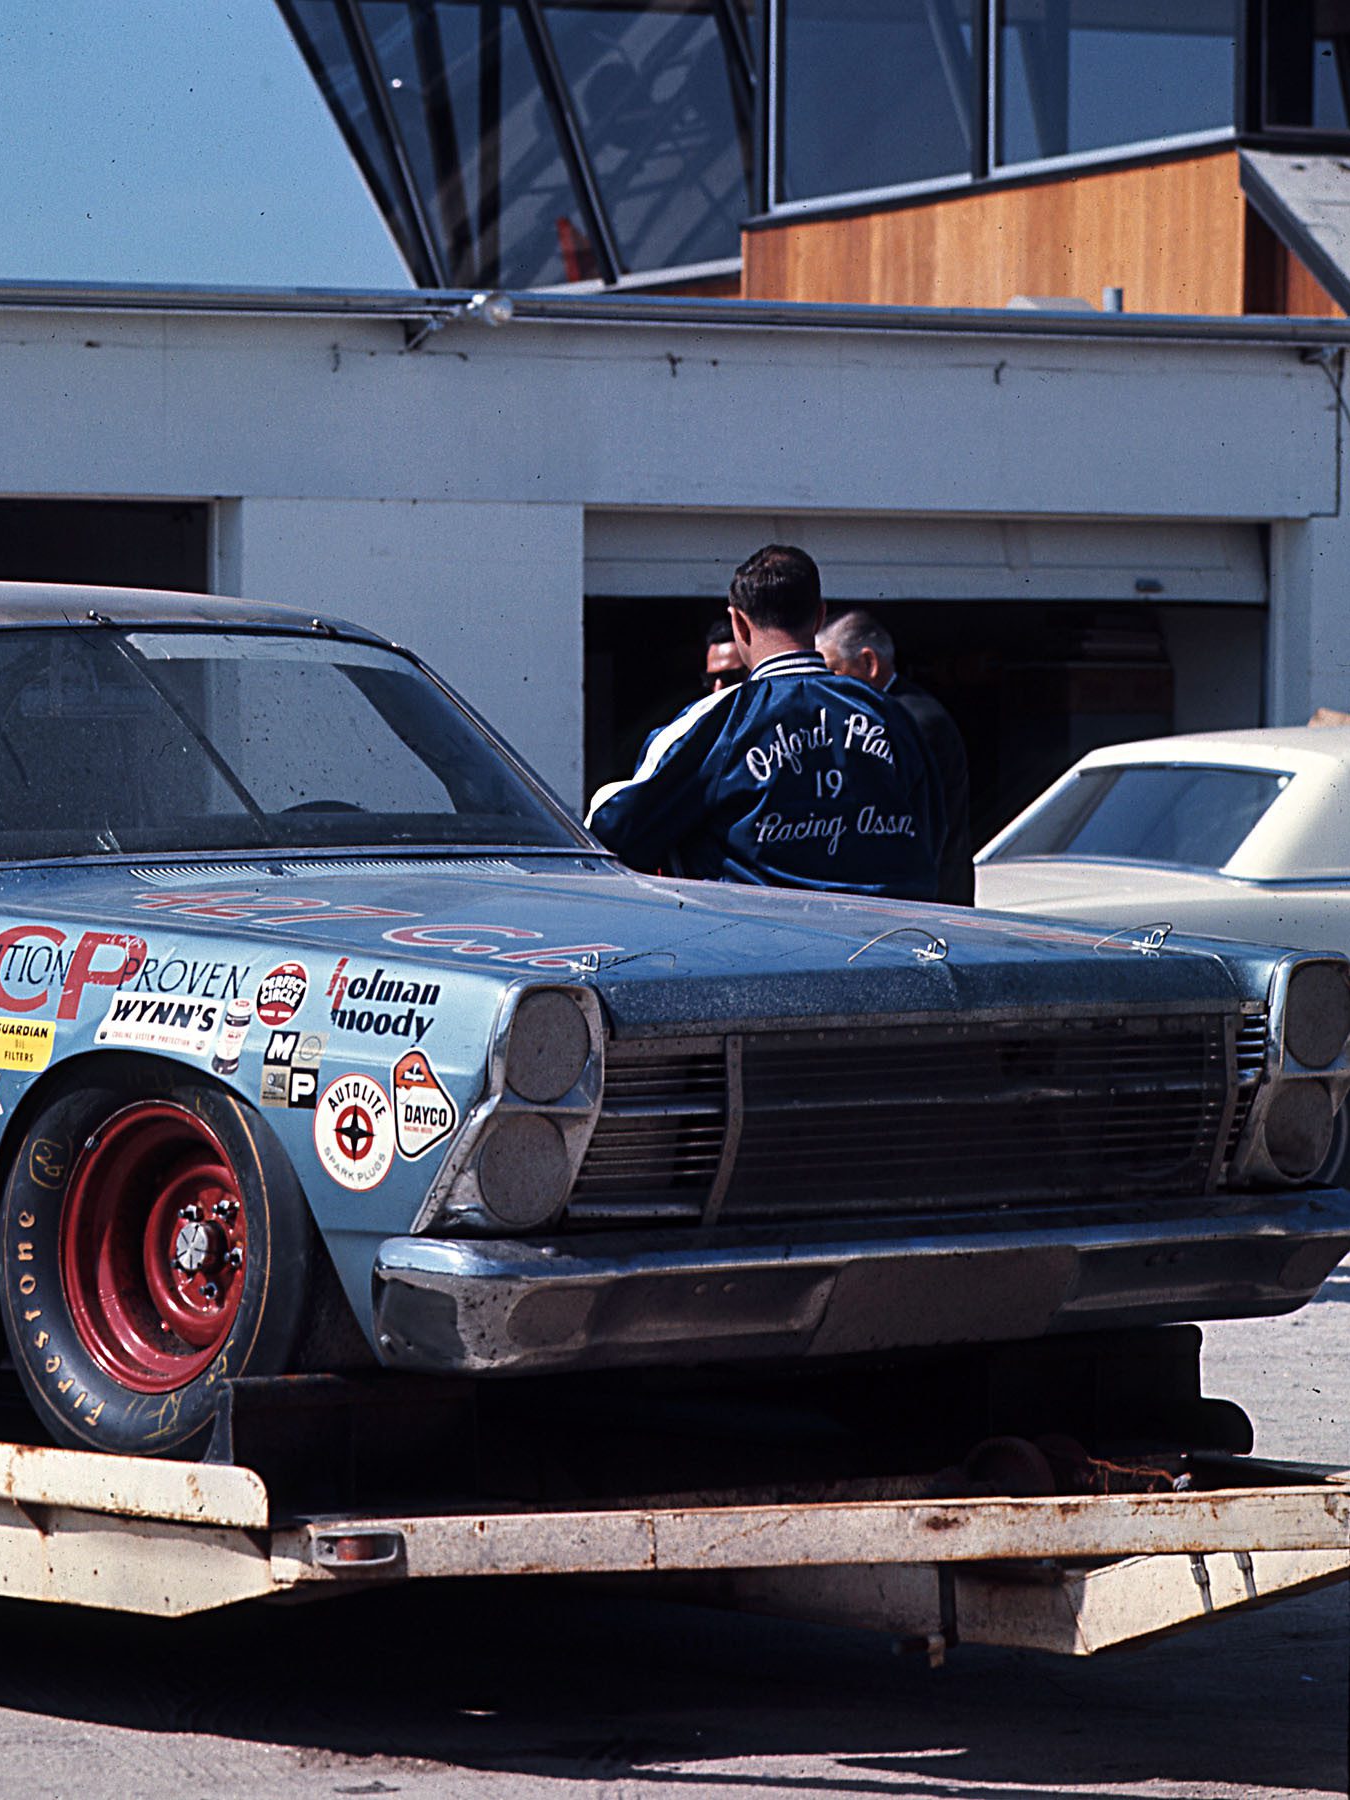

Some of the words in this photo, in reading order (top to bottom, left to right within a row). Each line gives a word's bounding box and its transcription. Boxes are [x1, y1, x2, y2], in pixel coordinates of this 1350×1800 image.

[745, 707, 833, 782] Oxford
[816, 769, 843, 798] 19
[755, 812, 847, 855] Racing
[857, 805, 915, 838] Assn.
[134, 891, 425, 924] 427
[116, 957, 251, 999] PROVEN
[261, 975, 307, 993] PERFECT
[325, 957, 441, 1009] holman
[260, 988, 300, 1007] CIRCLE
[111, 999, 217, 1032] WYNN'S
[330, 1007, 435, 1047] moody
[4, 1050, 34, 1063] FILTERS
[267, 1033, 297, 1060] M
[291, 1072, 316, 1102] P
[328, 1082, 387, 1119] AUTOLITE
[404, 1104, 447, 1127] DAYCO
[18, 1210, 107, 1427] Firestone
